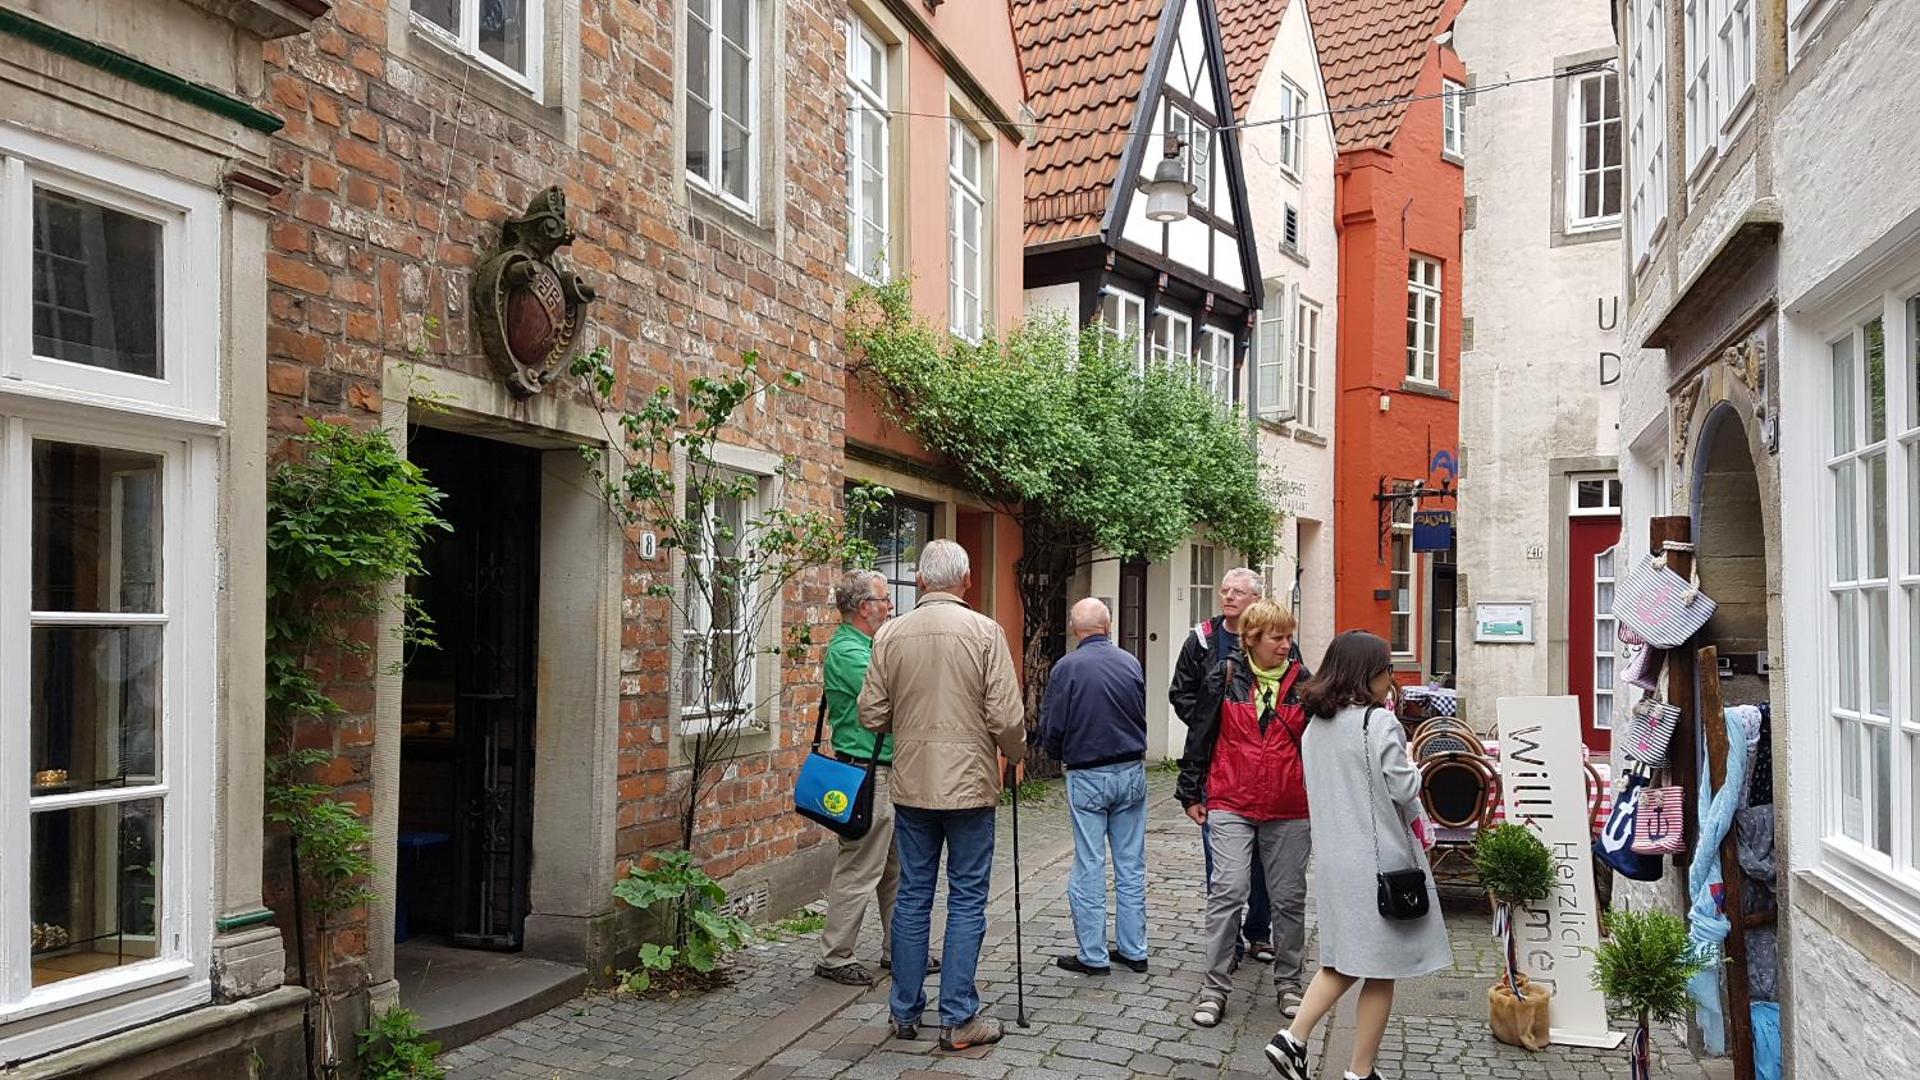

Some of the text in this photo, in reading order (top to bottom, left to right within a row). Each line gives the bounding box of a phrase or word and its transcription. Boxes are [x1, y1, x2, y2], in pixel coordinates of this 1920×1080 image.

[645, 534, 653, 556] 8
[1508, 725, 1558, 998] Willkmen
[1553, 842, 1587, 959] Herzlich
